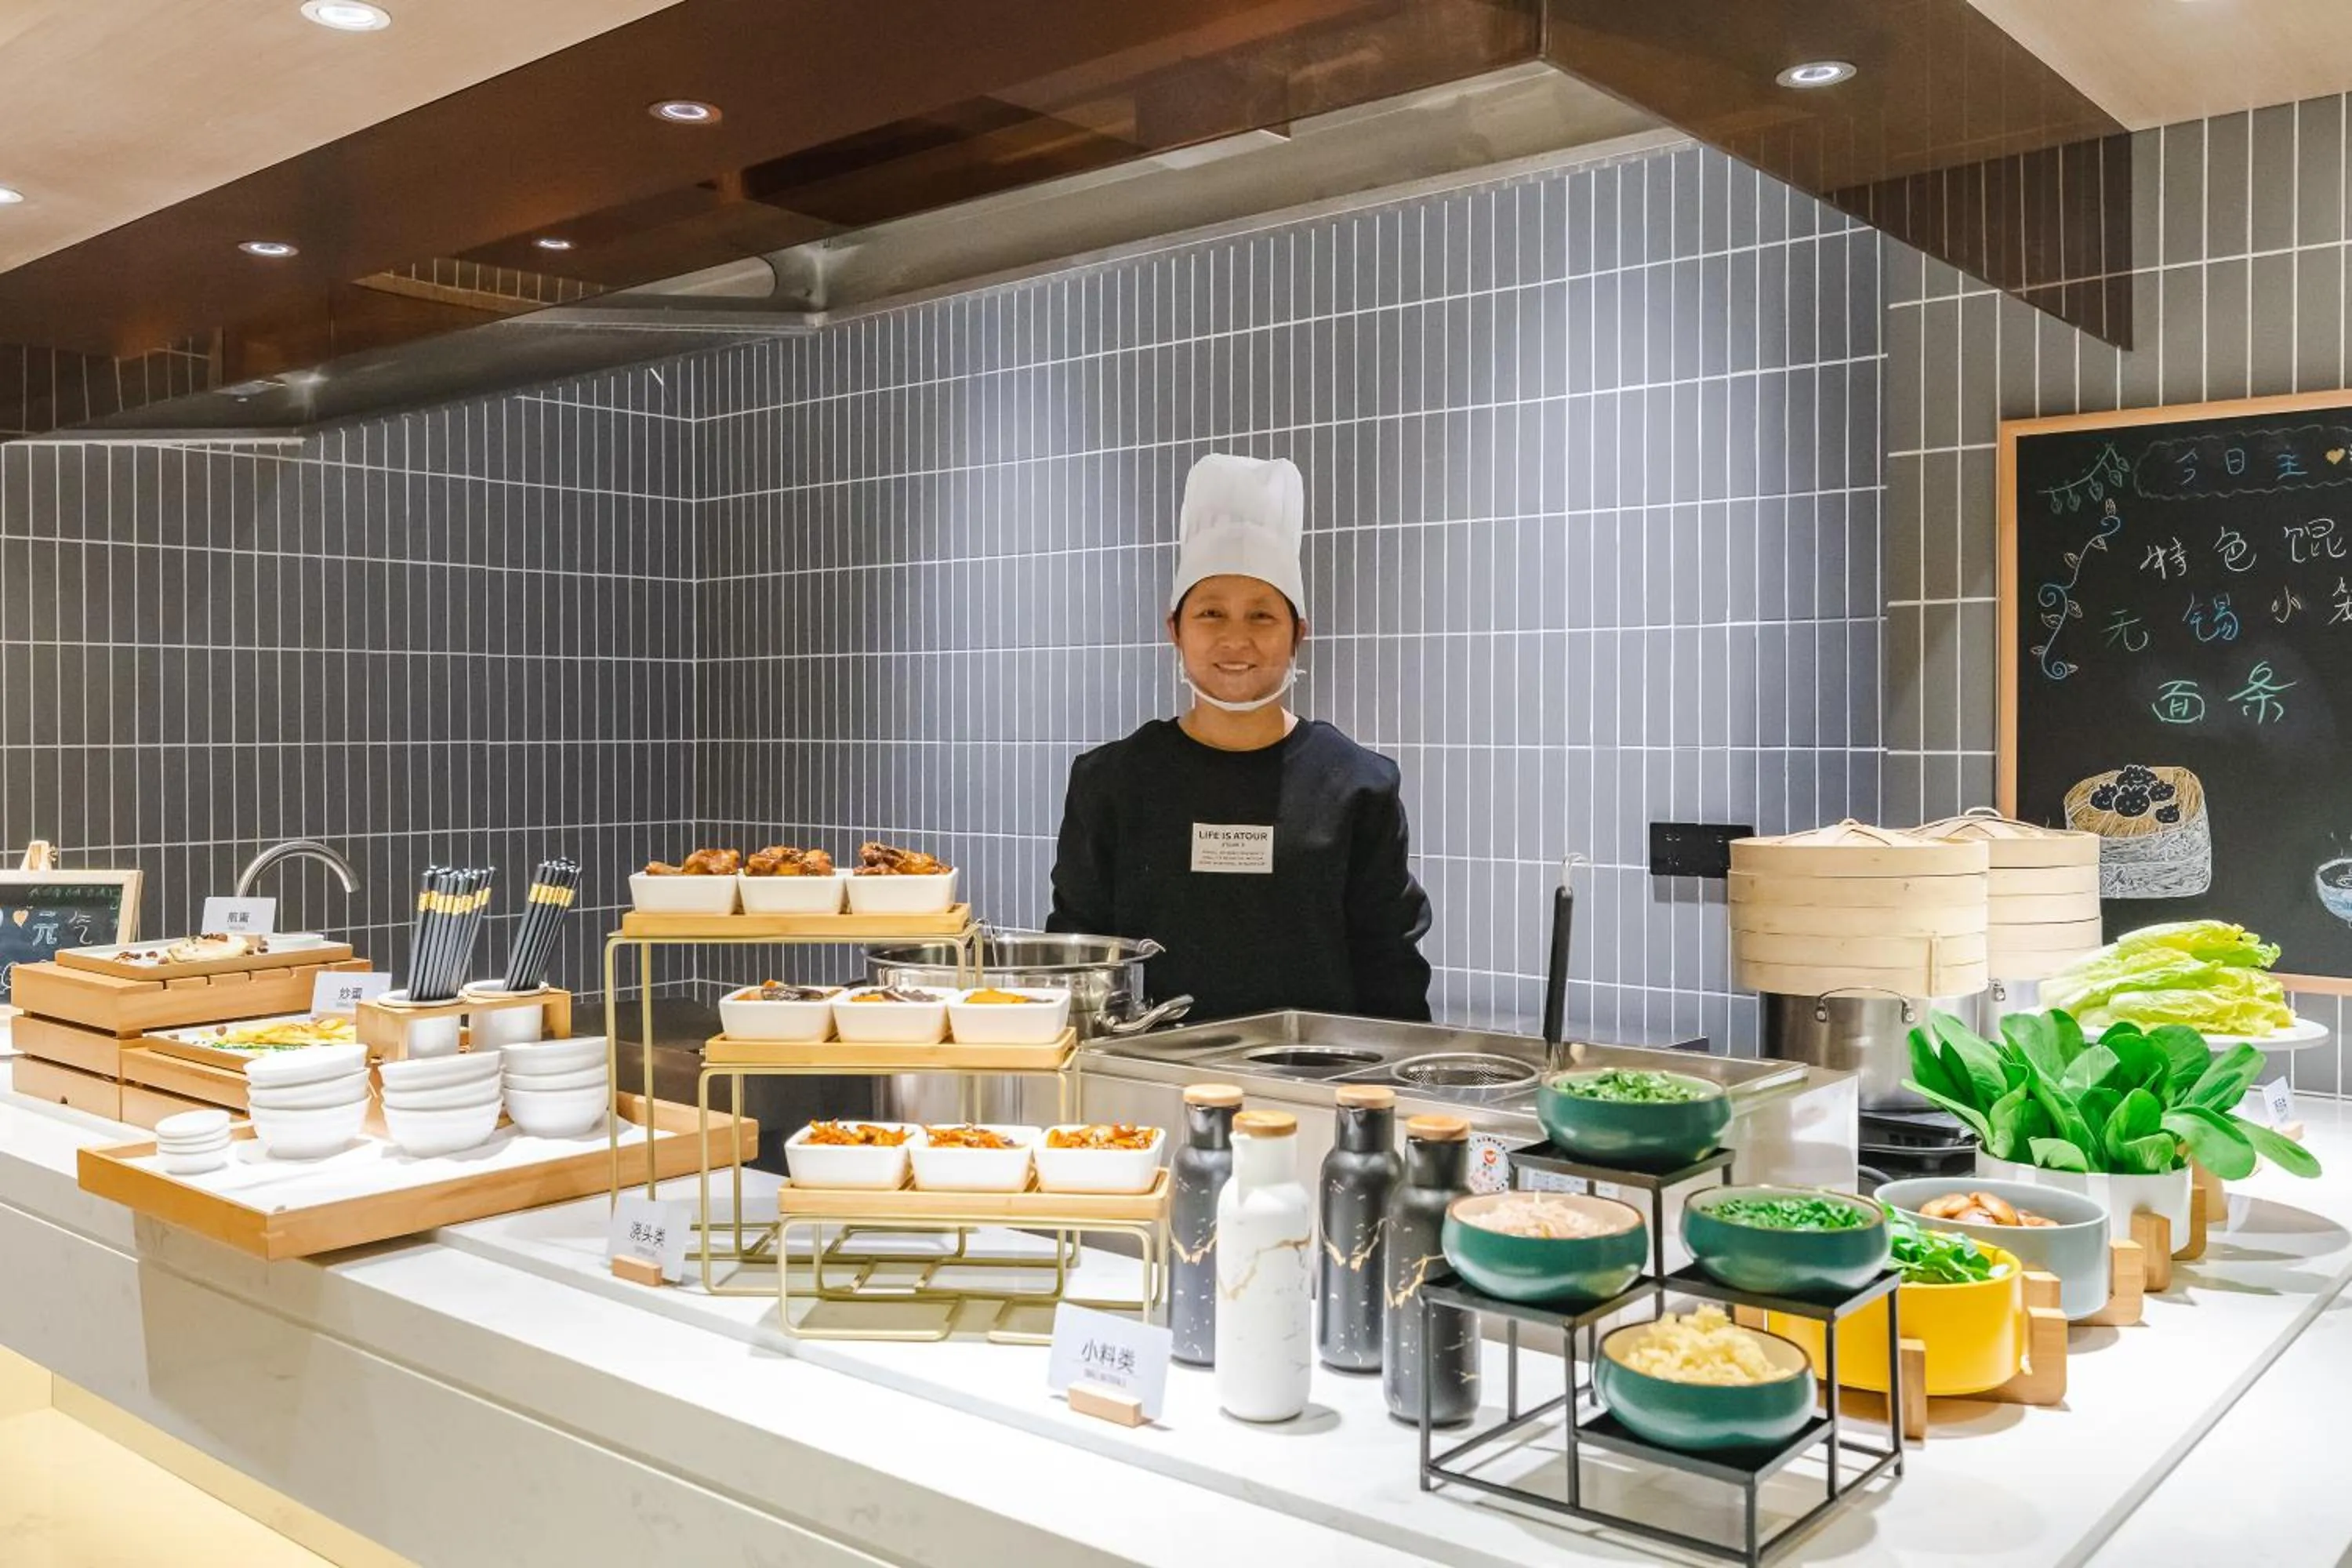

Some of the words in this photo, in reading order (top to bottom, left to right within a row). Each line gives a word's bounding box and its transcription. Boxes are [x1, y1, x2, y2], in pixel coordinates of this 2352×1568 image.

[2152, 661, 2297, 724] 面条
[1199, 830, 1219, 840] LIFE
[1233, 832, 1268, 841] ATOUR
[1081, 1338, 1135, 1374] 小料类
